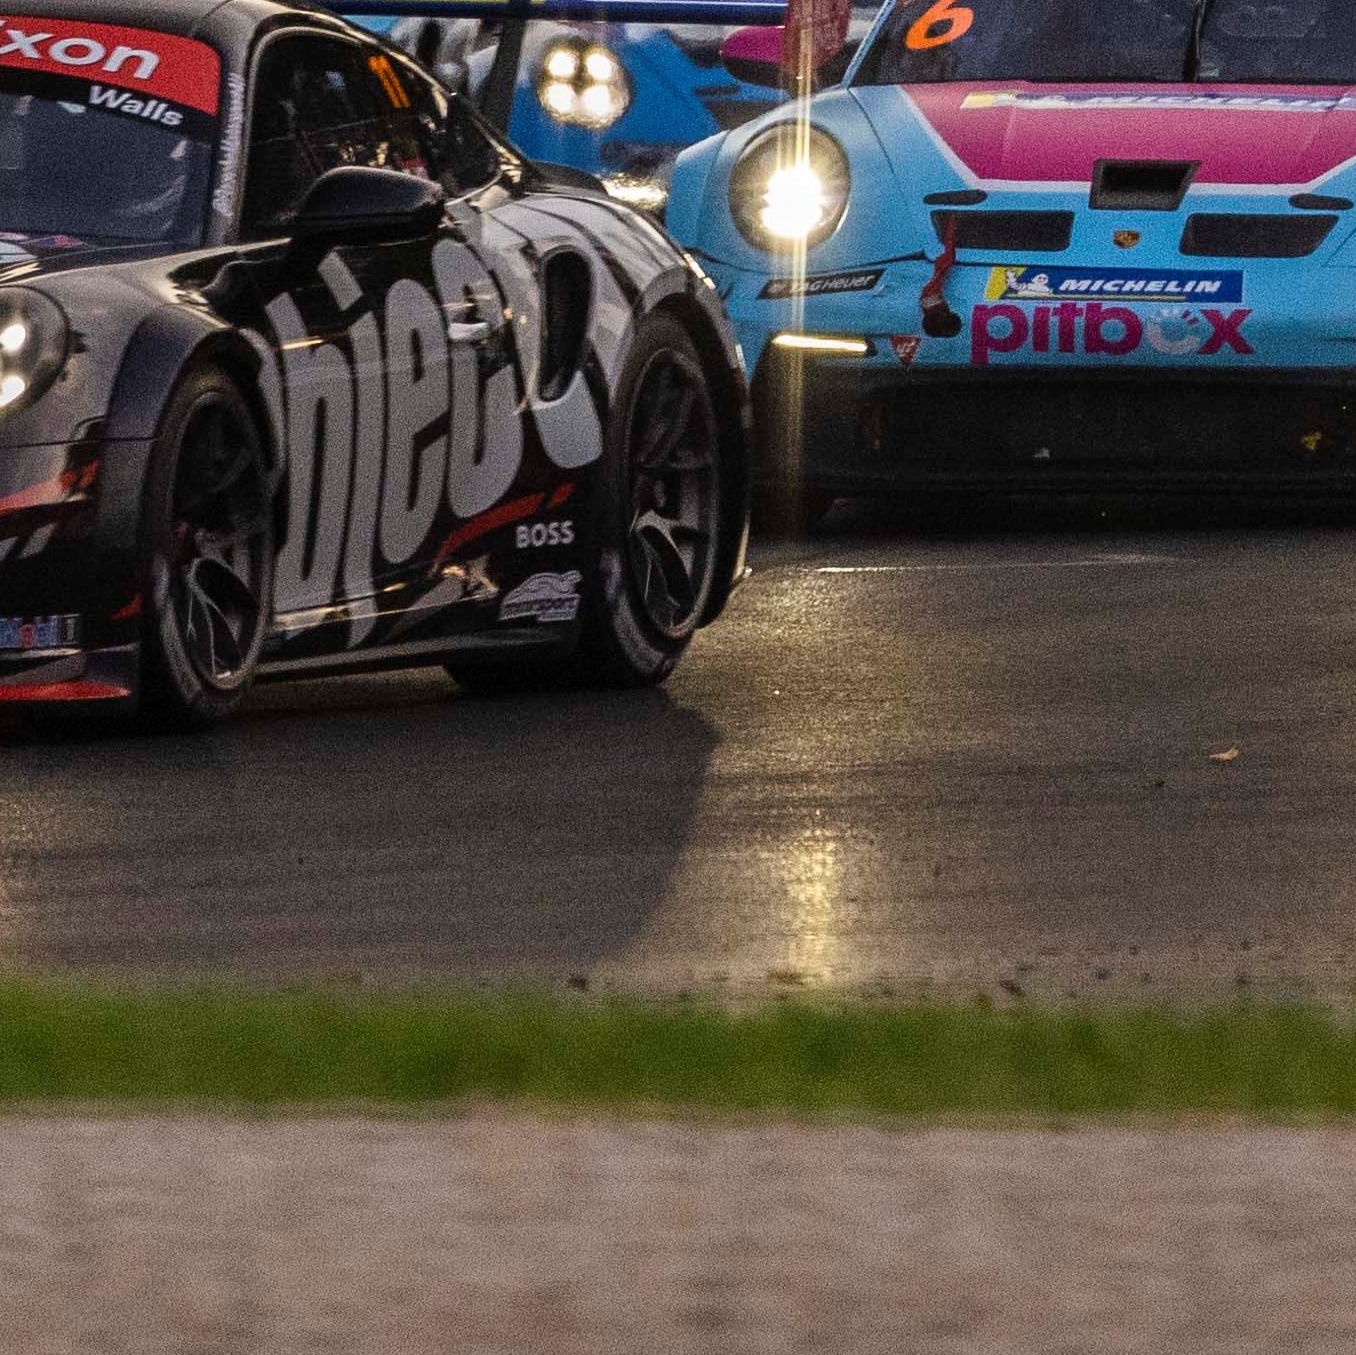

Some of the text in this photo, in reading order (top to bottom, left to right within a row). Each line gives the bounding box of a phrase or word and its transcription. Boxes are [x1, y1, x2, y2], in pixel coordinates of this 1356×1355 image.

[88, 84, 184, 128] Walls
[1058, 279, 1222, 294] MICHELIN
[515, 519, 576, 549] BOSS
